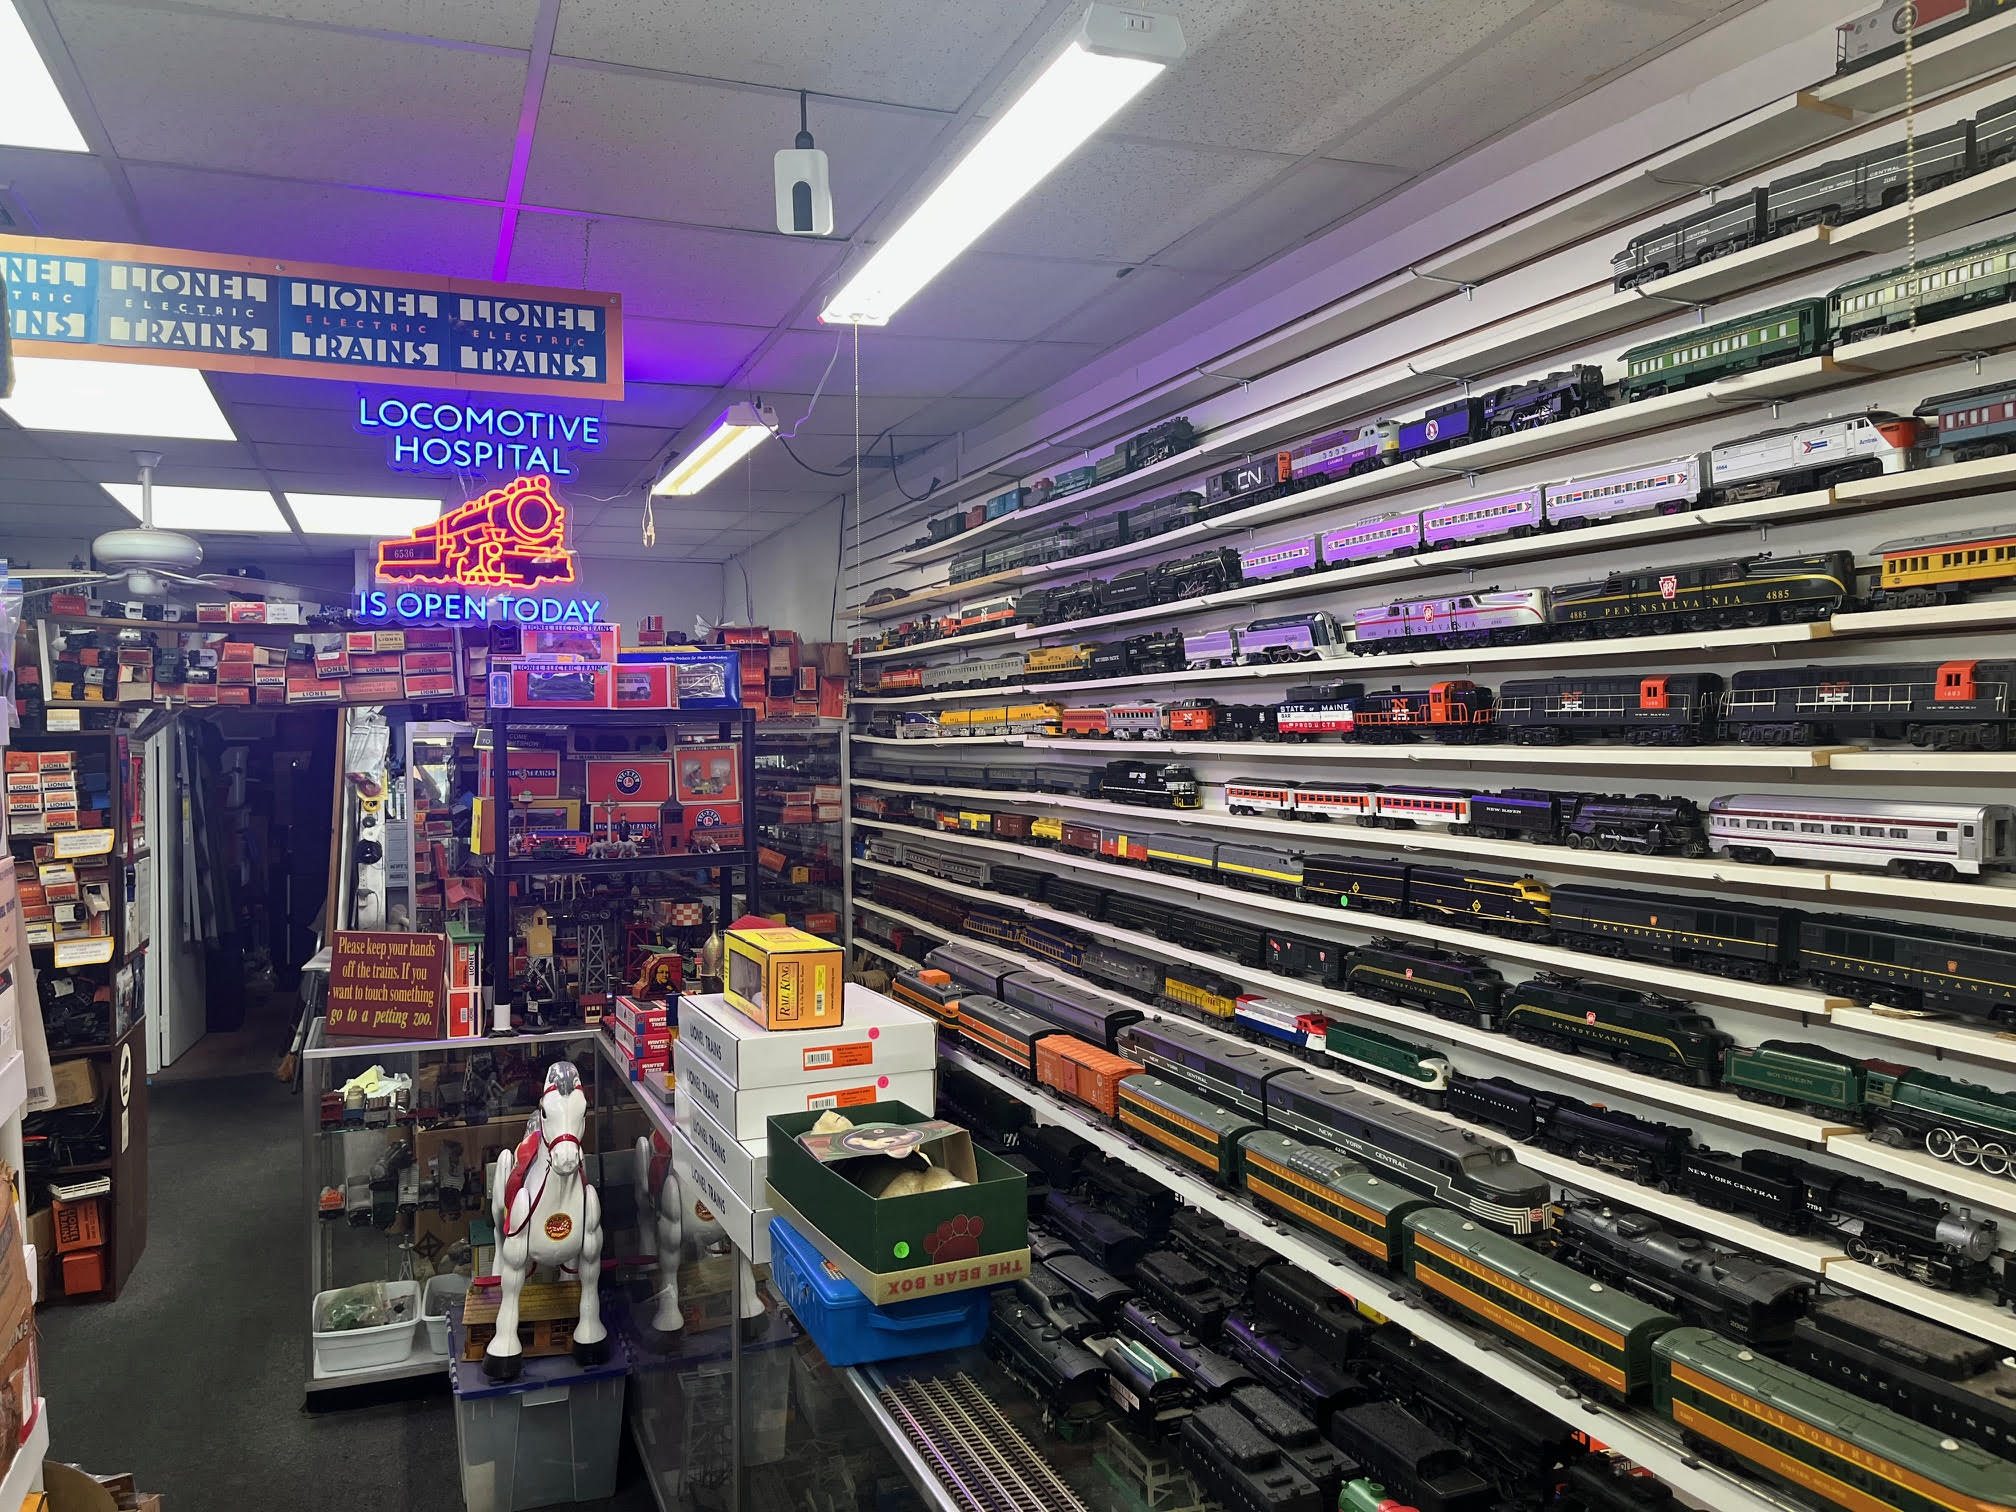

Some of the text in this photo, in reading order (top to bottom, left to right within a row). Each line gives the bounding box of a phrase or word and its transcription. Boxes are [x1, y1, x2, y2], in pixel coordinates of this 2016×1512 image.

[1869, 165, 1900, 178] CENTRAL
[110, 265, 267, 303] LIONEL
[125, 299, 255, 319] ELECTRIC
[291, 282, 438, 318] LIONEL
[306, 315, 427, 335] ELECTRIC
[459, 298, 596, 332] LIONEL
[110, 316, 268, 352] TRAINS
[473, 329, 586, 347] ELECTRIC
[292, 331, 439, 367] TRAINS
[460, 346, 597, 378] TRAINS
[359, 397, 600, 444] LOCOMOTIVE
[394, 434, 571, 476] HOSPITAL
[1237, 466, 1263, 491] CN
[394, 549, 415, 559] 6536
[359, 590, 387, 617] IS
[396, 592, 487, 621] OPEN
[496, 596, 601, 625] TODAY
[1570, 590, 1790, 620] 4885 PENNSYLVANIA 4885
[320, 664, 346, 674] LIONEL
[366, 666, 386, 674] LIONEL
[302, 690, 328, 698] LIONEL
[1321, 703, 1350, 711] MAINE
[43, 762, 66, 770] LIONEL
[14, 802, 36, 810] LIONEL
[48, 820, 71, 828] LIONEL
[338, 936, 436, 960] Please keep your hands
[1593, 922, 1724, 948] PENNSYLVANIA
[342, 961, 428, 984] off the trains. If you
[1380, 978, 1437, 996] PENNSYLVANIA
[1830, 960, 2012, 998] PENNSYLVANIA
[332, 984, 434, 1008] want to touch something
[780, 964, 790, 1016] RAIL KING
[330, 1006, 432, 1028] go to a petting zoo.
[690, 1023, 722, 1060] LIONEL TRAINS
[1552, 1021, 1630, 1046] PENNSYLVANIA
[1149, 1056, 1159, 1064] NEW
[1186, 1070, 1208, 1085] CENTRAL
[1766, 1070, 1814, 1086] SOUTHERN
[686, 1068, 720, 1109] LIONEL TRAINS
[1490, 1100, 1518, 1113] CENTRAL
[692, 1118, 726, 1164] LIONEL TRAINS
[1318, 1127, 1408, 1170] NEW YORK CENTRAL
[690, 1164, 726, 1215] LIONEL TRAINS
[1687, 1166, 1781, 1202] NEW YORK CENTRAL
[888, 1260, 1023, 1296] THE BEAR BOX
[1450, 1252, 1561, 1315] GREAT NORTHERN
[1810, 1352, 1908, 1400] LIONEL
[1730, 1392, 1904, 1480] GREAT NORTHERN
